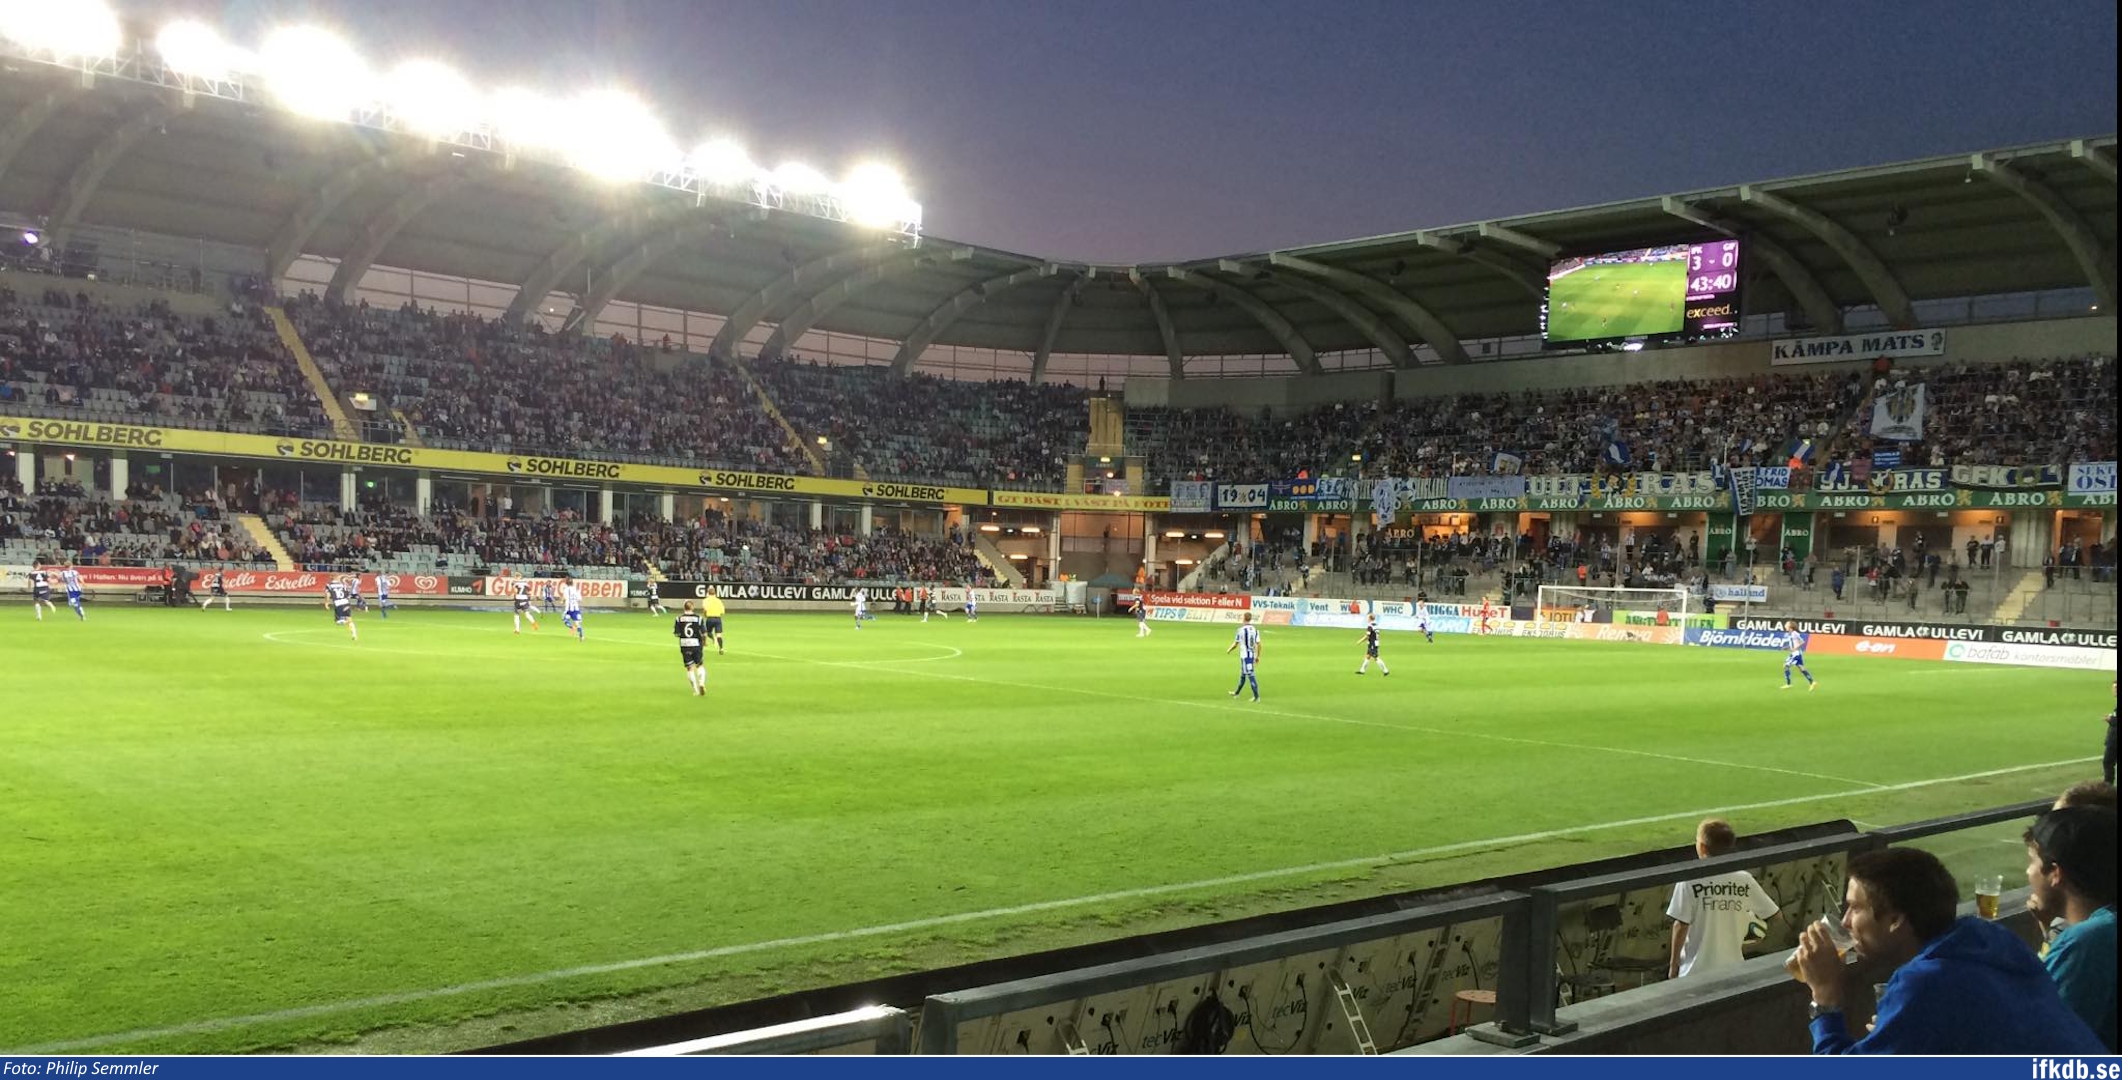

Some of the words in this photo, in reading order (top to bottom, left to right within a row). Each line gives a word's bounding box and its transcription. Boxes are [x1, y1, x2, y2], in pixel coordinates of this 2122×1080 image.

[1692, 256, 1701, 270] 3
[1722, 252, 1733, 267] 0
[1690, 274, 1732, 292] 43:40
[1862, 334, 1925, 352] MATS
[28, 421, 162, 446] SOHLBERG
[300, 441, 412, 464] SOHLBERG
[526, 458, 620, 479] SOHLBERG
[715, 472, 795, 490] SOHLBERG
[1756, 477, 1787, 488] OMAS
[876, 484, 945, 500] SOHLBERG
[1222, 489, 1238, 502] 19
[265, 573, 316, 590] Estrella
[695, 584, 747, 598] GMLA
[760, 586, 806, 599] ULLEVI
[812, 587, 857, 600] GAMLA
[870, 589, 898, 600] ULLE
[1171, 595, 1183, 604] vid
[1184, 596, 1211, 606] sektion
[1212, 597, 1217, 605] F
[1218, 597, 1234, 606] eller
[1235, 598, 1242, 607] N
[1253, 599, 1295, 610] VVS-Teknik
[1309, 602, 1329, 611] Vent
[1154, 607, 1176, 618] TIPS
[1382, 605, 1404, 614] WHC
[684, 623, 694, 637] 6
[1736, 620, 1784, 632] GAMLA
[1798, 621, 1846, 634] ULLEVI
[1862, 624, 1916, 638] GAMLA
[1931, 627, 1984, 641] ULLEVI
[2002, 630, 2060, 645] GAMLA
[1967, 644, 2010, 660] bafab
[1692, 881, 1750, 898] Prioritet
[1352, 986, 1369, 1000] Viz
[1234, 1011, 1251, 1027] Viz
[1142, 1029, 1183, 1049] tecViz
